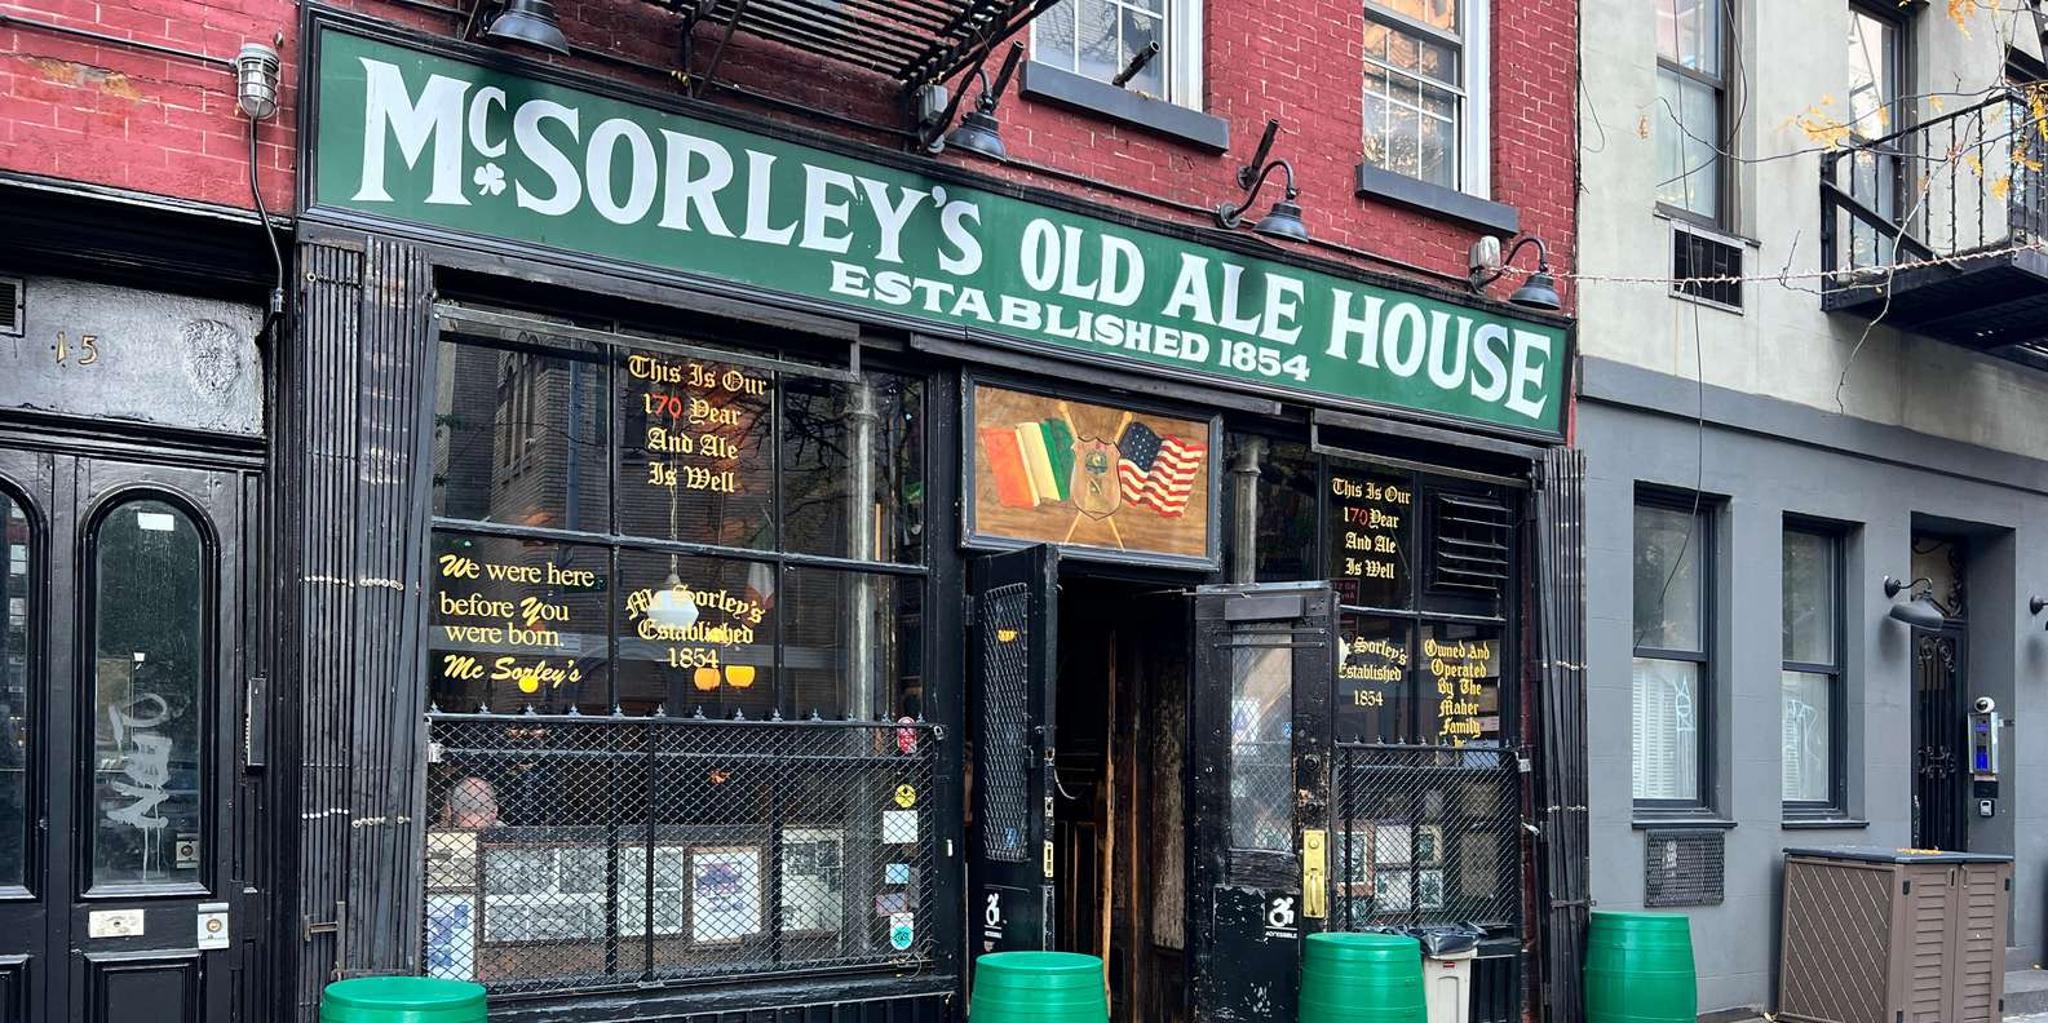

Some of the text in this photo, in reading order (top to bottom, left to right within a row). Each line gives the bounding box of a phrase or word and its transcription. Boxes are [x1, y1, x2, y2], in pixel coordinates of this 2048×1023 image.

[829, 260, 1311, 382] ESTABLISHED 1854
[1020, 218, 1145, 307] OLD
[1165, 252, 1305, 345] ALE
[1326, 286, 1552, 420] HOUSE
[56, 331, 98, 366] 15
[628, 355, 767, 396] This Is Our
[643, 393, 742, 425] 170 Year
[647, 427, 739, 460] And Ale
[648, 462, 735, 493] Is Well
[1331, 477, 1412, 505] This Is Our
[1343, 506, 1400, 529] 170 Year
[1345, 531, 1397, 554] And Ale
[439, 554, 595, 587] We were here
[1345, 557, 1395, 580] Is Well
[439, 591, 570, 627] before You
[445, 622, 565, 647] were born.
[637, 618, 754, 647] Established
[668, 647, 719, 668] 1854
[1354, 636, 1408, 666] Sorley's
[1424, 638, 1490, 660] Owned And
[443, 654, 582, 689] Mc Sorley's
[1430, 658, 1487, 680] Operated
[1354, 689, 1384, 706] 1854
[1437, 677, 1482, 699] By The
[1438, 699, 1479, 717] Maher
[1439, 717, 1481, 739] Family
